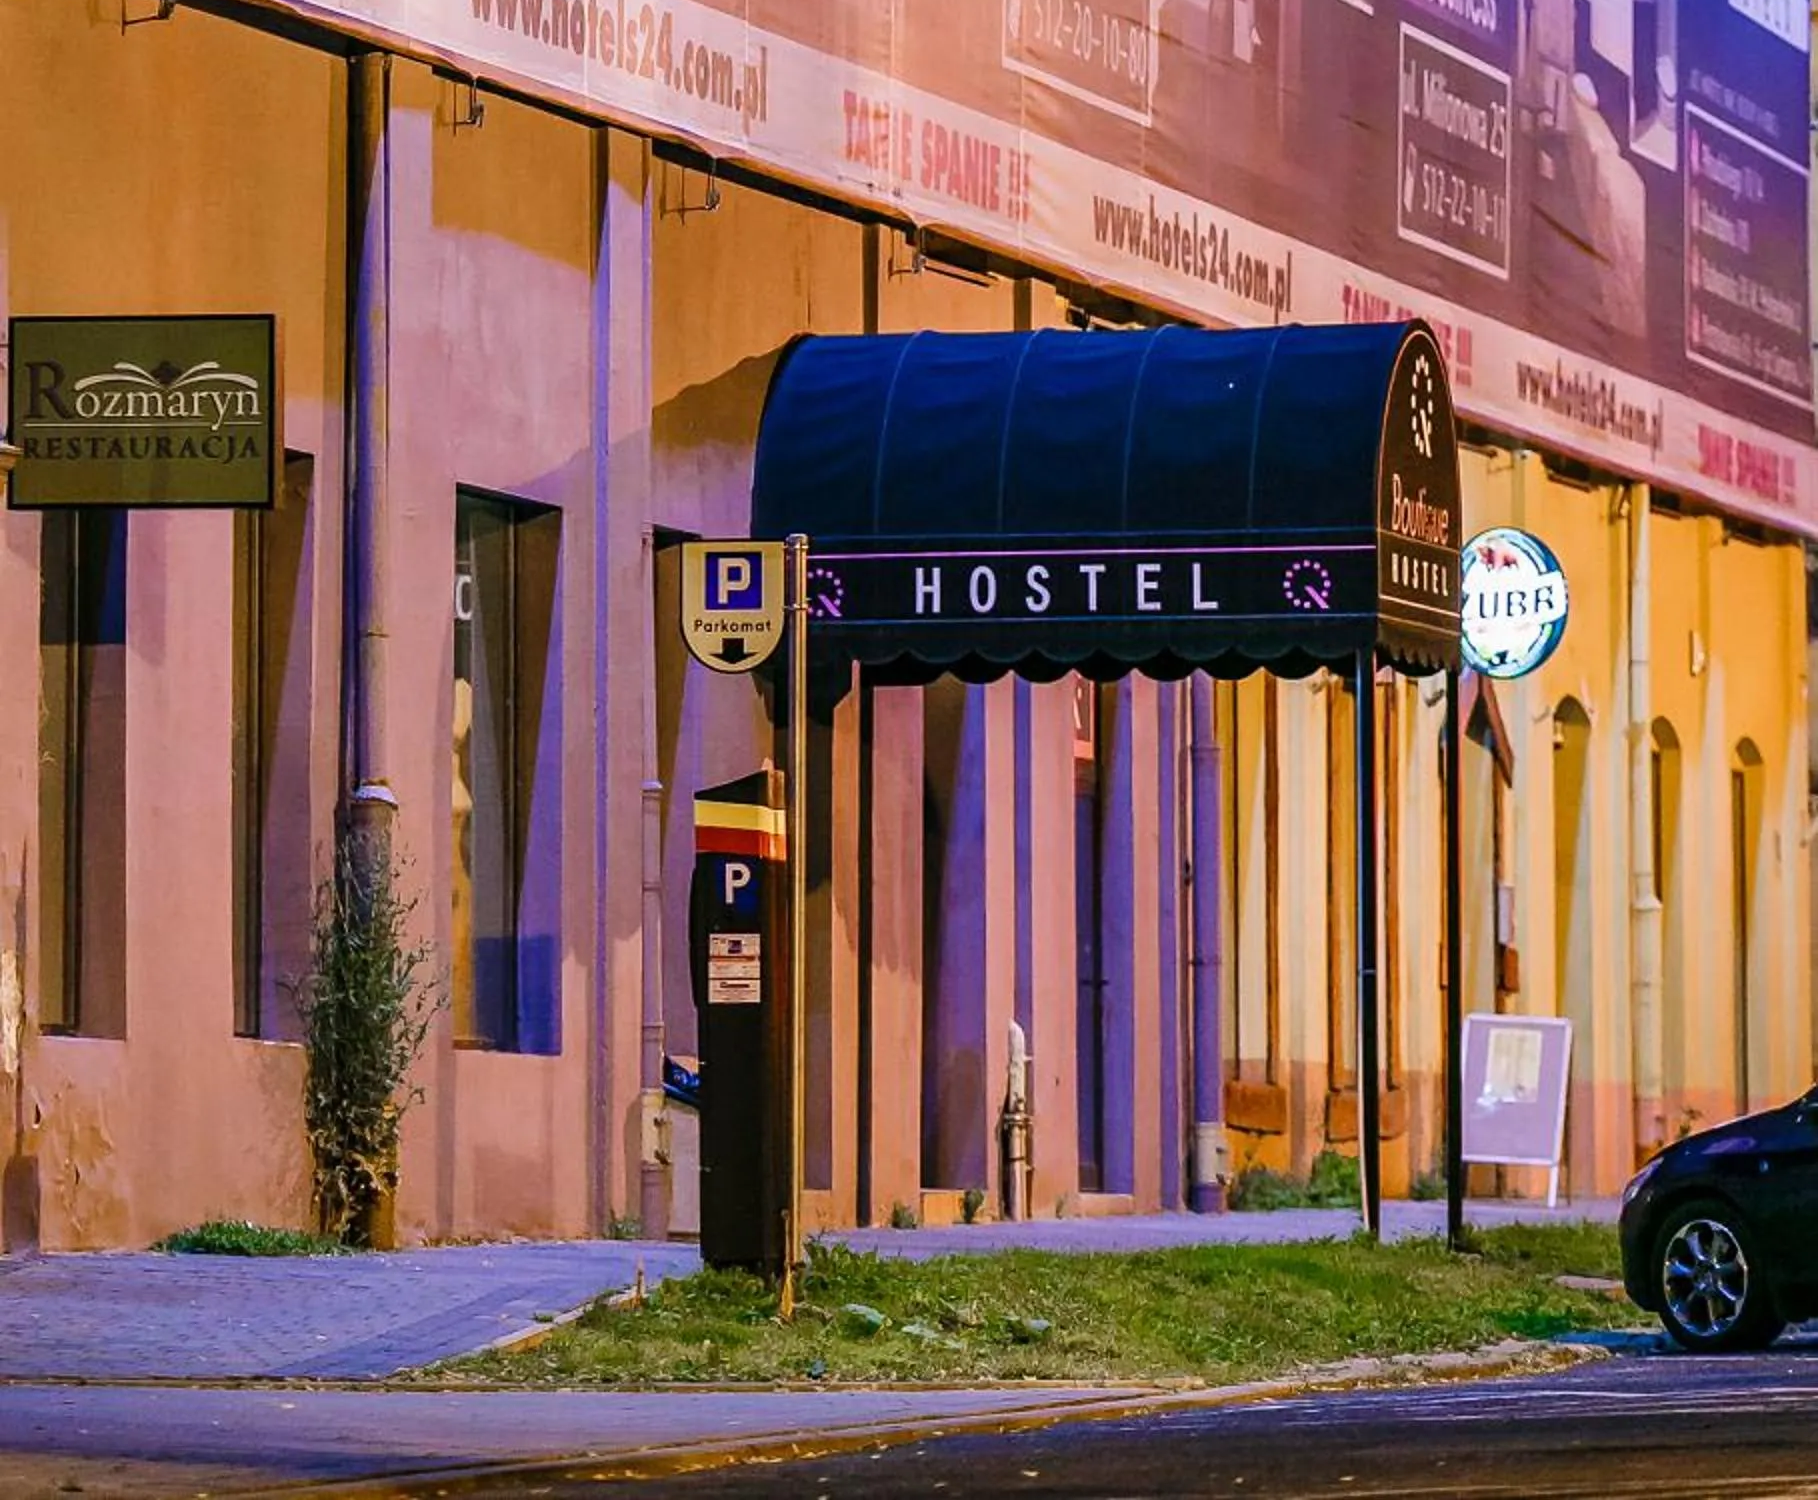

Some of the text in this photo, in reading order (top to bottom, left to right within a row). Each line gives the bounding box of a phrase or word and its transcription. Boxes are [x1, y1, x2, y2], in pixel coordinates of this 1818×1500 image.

[921, 119, 1000, 212] SPANIE
[1093, 193, 1292, 325] www.hotels24.com.pl
[24, 358, 261, 432] Rozmaryn
[24, 435, 261, 465] RESTAURACJA
[717, 557, 751, 605] P
[914, 562, 1219, 616] HOSTEL
[1391, 552, 1449, 597] HOSTEL
[1463, 585, 1554, 619] UBR
[694, 619, 771, 633] Parkomat
[725, 862, 751, 905] P
